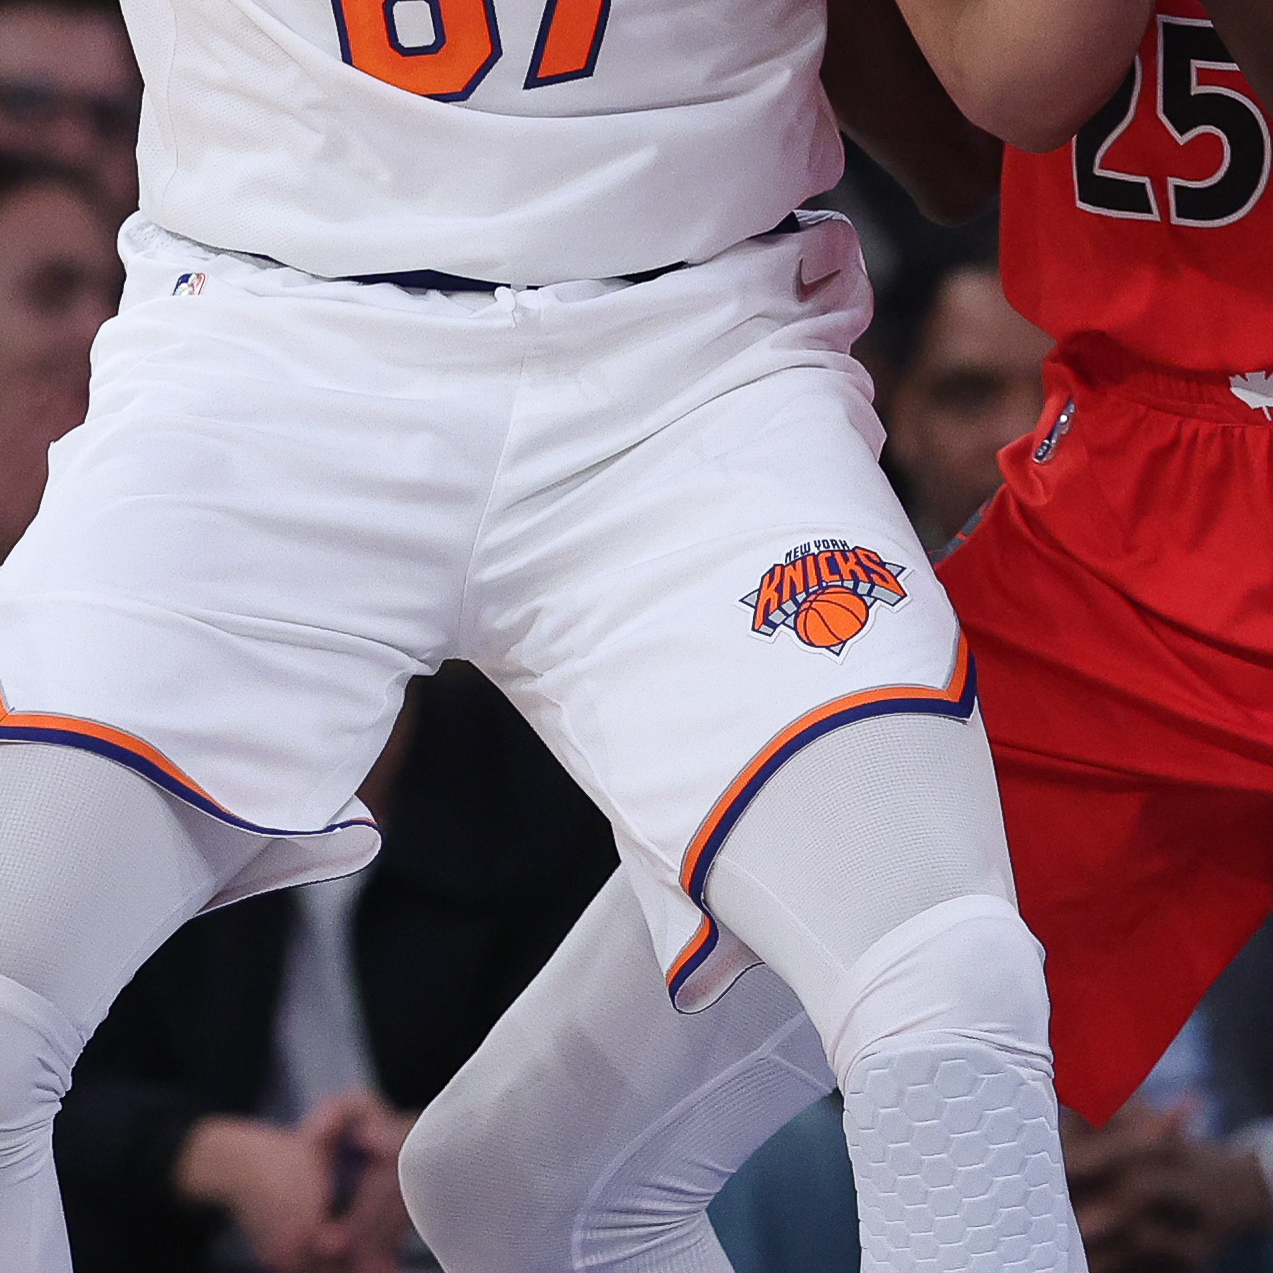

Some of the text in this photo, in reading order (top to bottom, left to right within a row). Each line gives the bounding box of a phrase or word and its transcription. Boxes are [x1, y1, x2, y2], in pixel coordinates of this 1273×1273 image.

[1072, 14, 1272, 228] 25
[751, 546, 908, 633] KNICKS
[784, 539, 850, 563] NEW YORK
